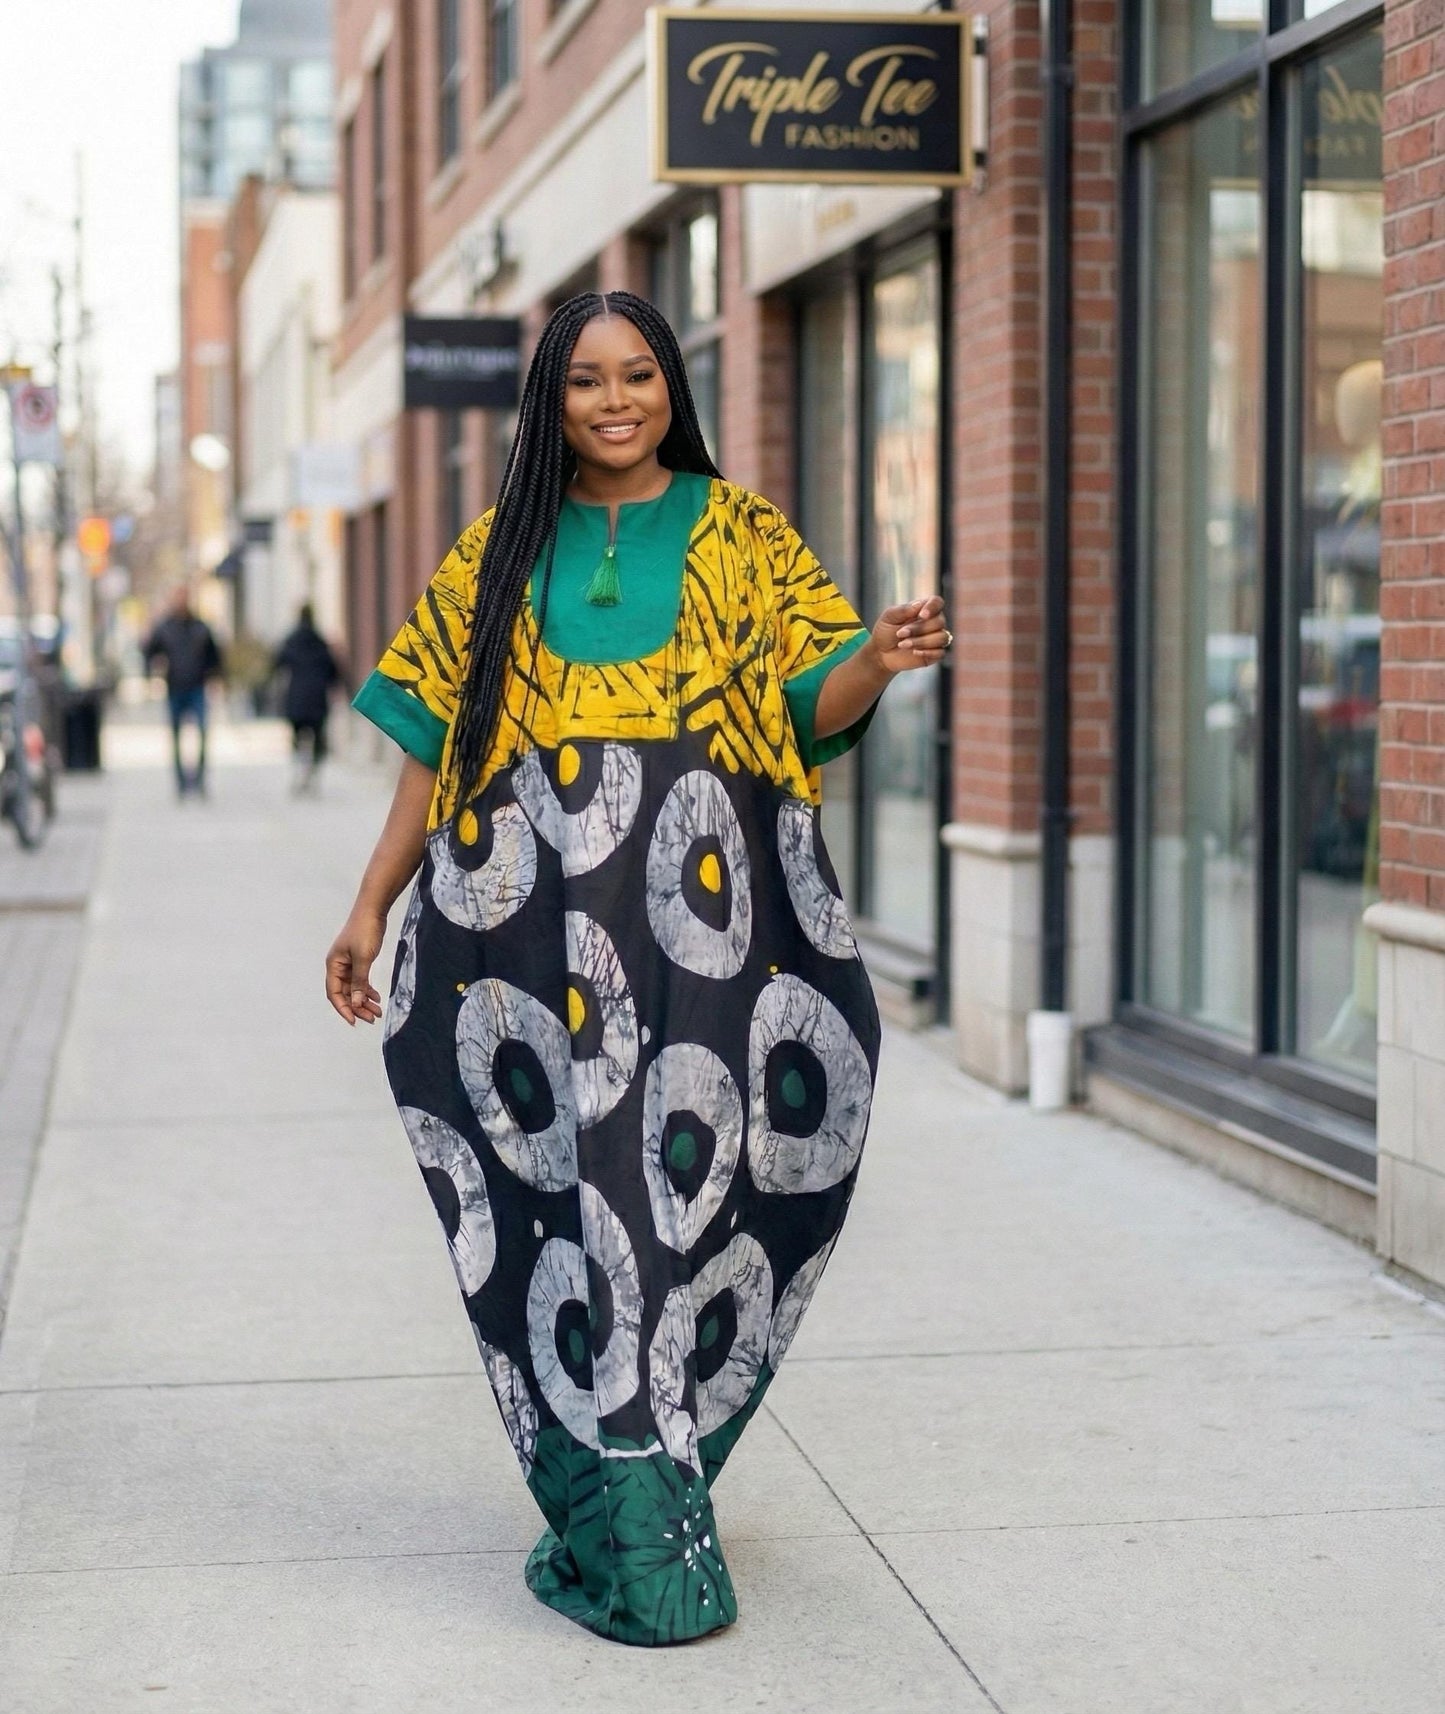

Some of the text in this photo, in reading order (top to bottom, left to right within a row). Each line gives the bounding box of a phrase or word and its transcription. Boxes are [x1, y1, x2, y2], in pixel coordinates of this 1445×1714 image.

[687, 42, 939, 147] Triple Tee
[785, 124, 920, 150] FASHION
